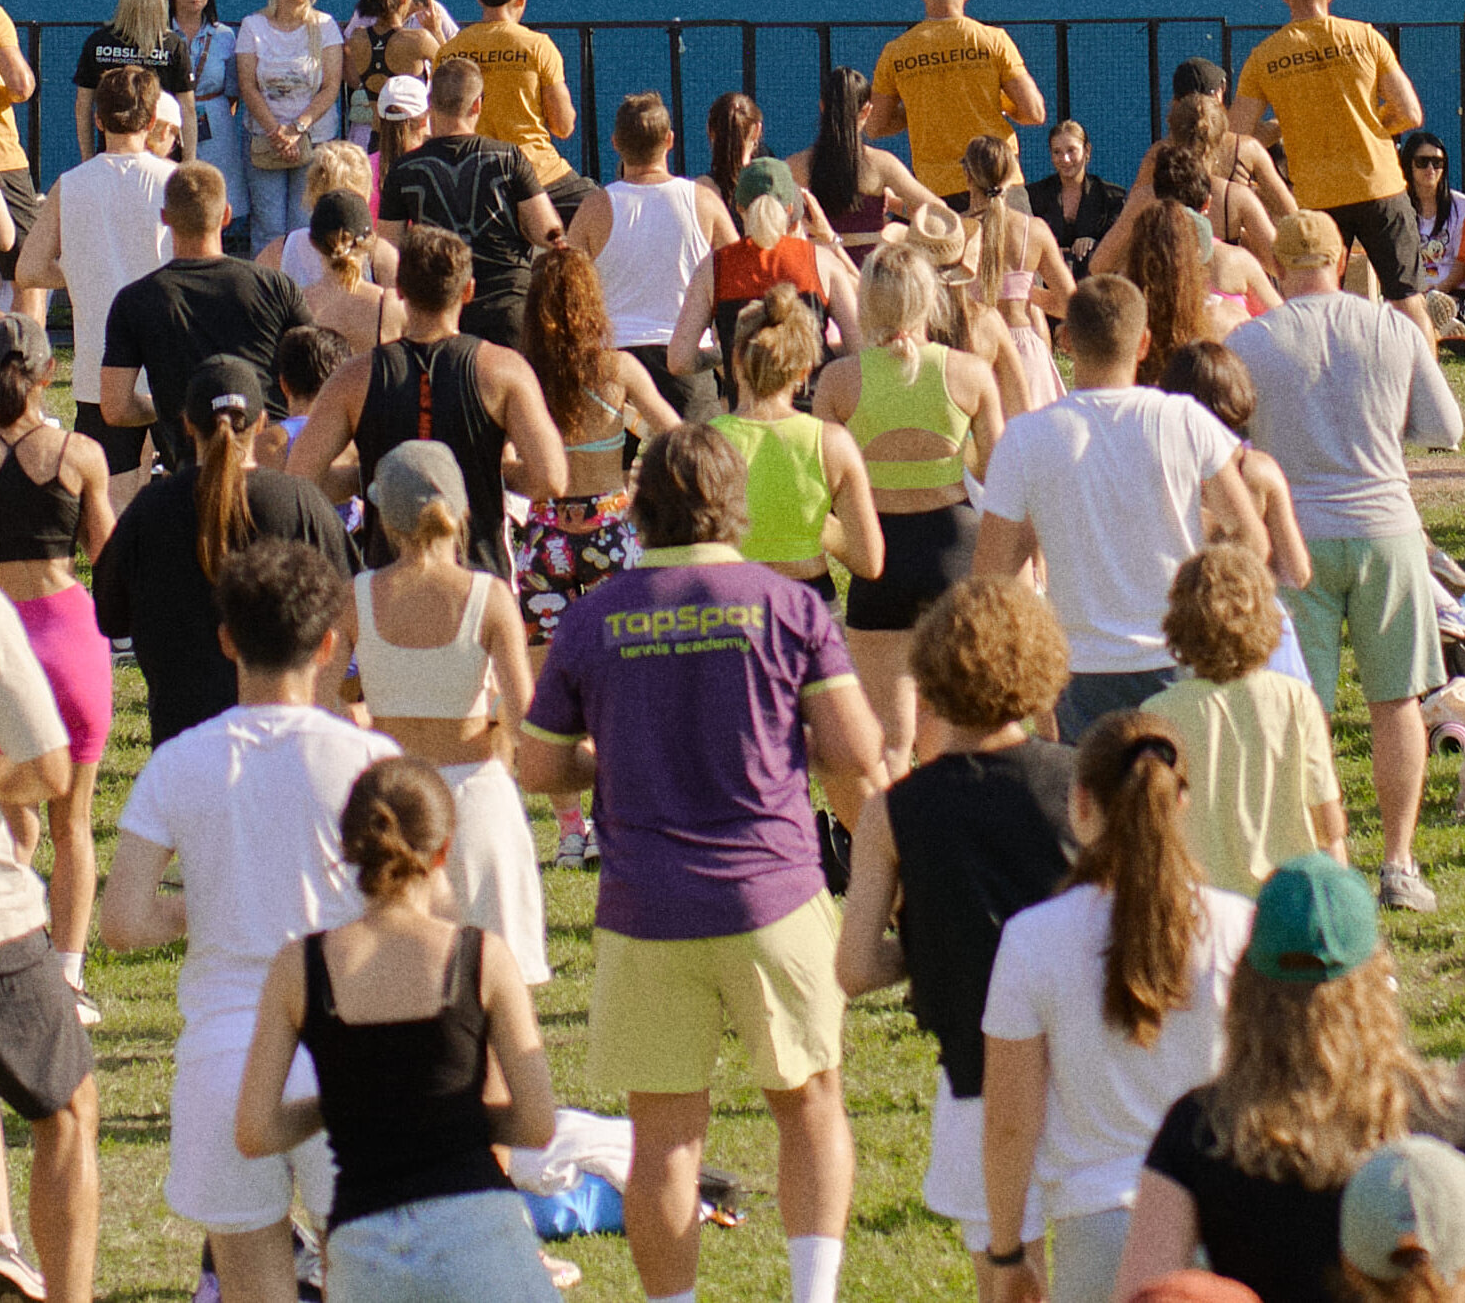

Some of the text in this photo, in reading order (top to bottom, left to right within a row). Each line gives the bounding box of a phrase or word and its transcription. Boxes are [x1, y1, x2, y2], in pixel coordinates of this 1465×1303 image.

[95, 46, 170, 60] BOBSLGH
[893, 47, 990, 73] BOBSLEIGH
[620, 636, 751, 660] tennis academy
